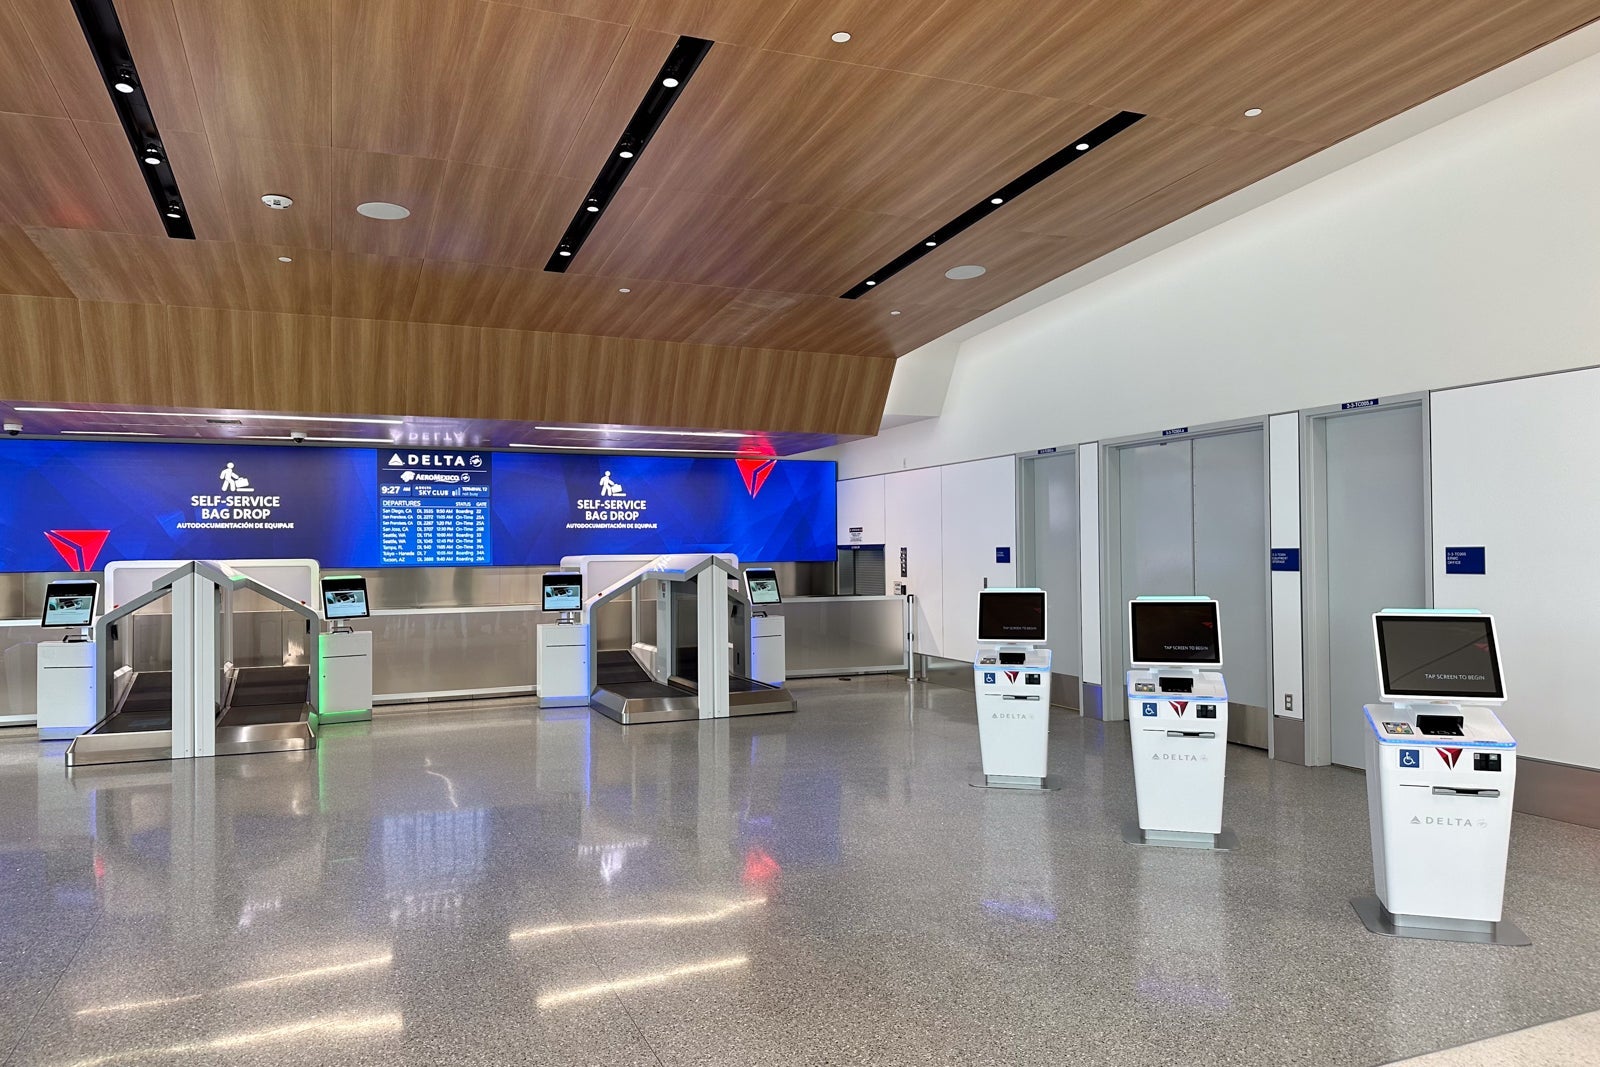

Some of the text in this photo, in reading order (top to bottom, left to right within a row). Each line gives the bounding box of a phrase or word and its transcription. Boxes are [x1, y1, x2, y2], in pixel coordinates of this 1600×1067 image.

[408, 454, 465, 466] DELTA
[382, 486, 400, 494] 9:27
[191, 496, 280, 507] SELF-SERVICE
[577, 499, 646, 510] SELF-SERVICE
[202, 508, 270, 519] BAG DROP
[585, 511, 639, 520] BAG DROP
[1425, 817, 1472, 827] DELTA
